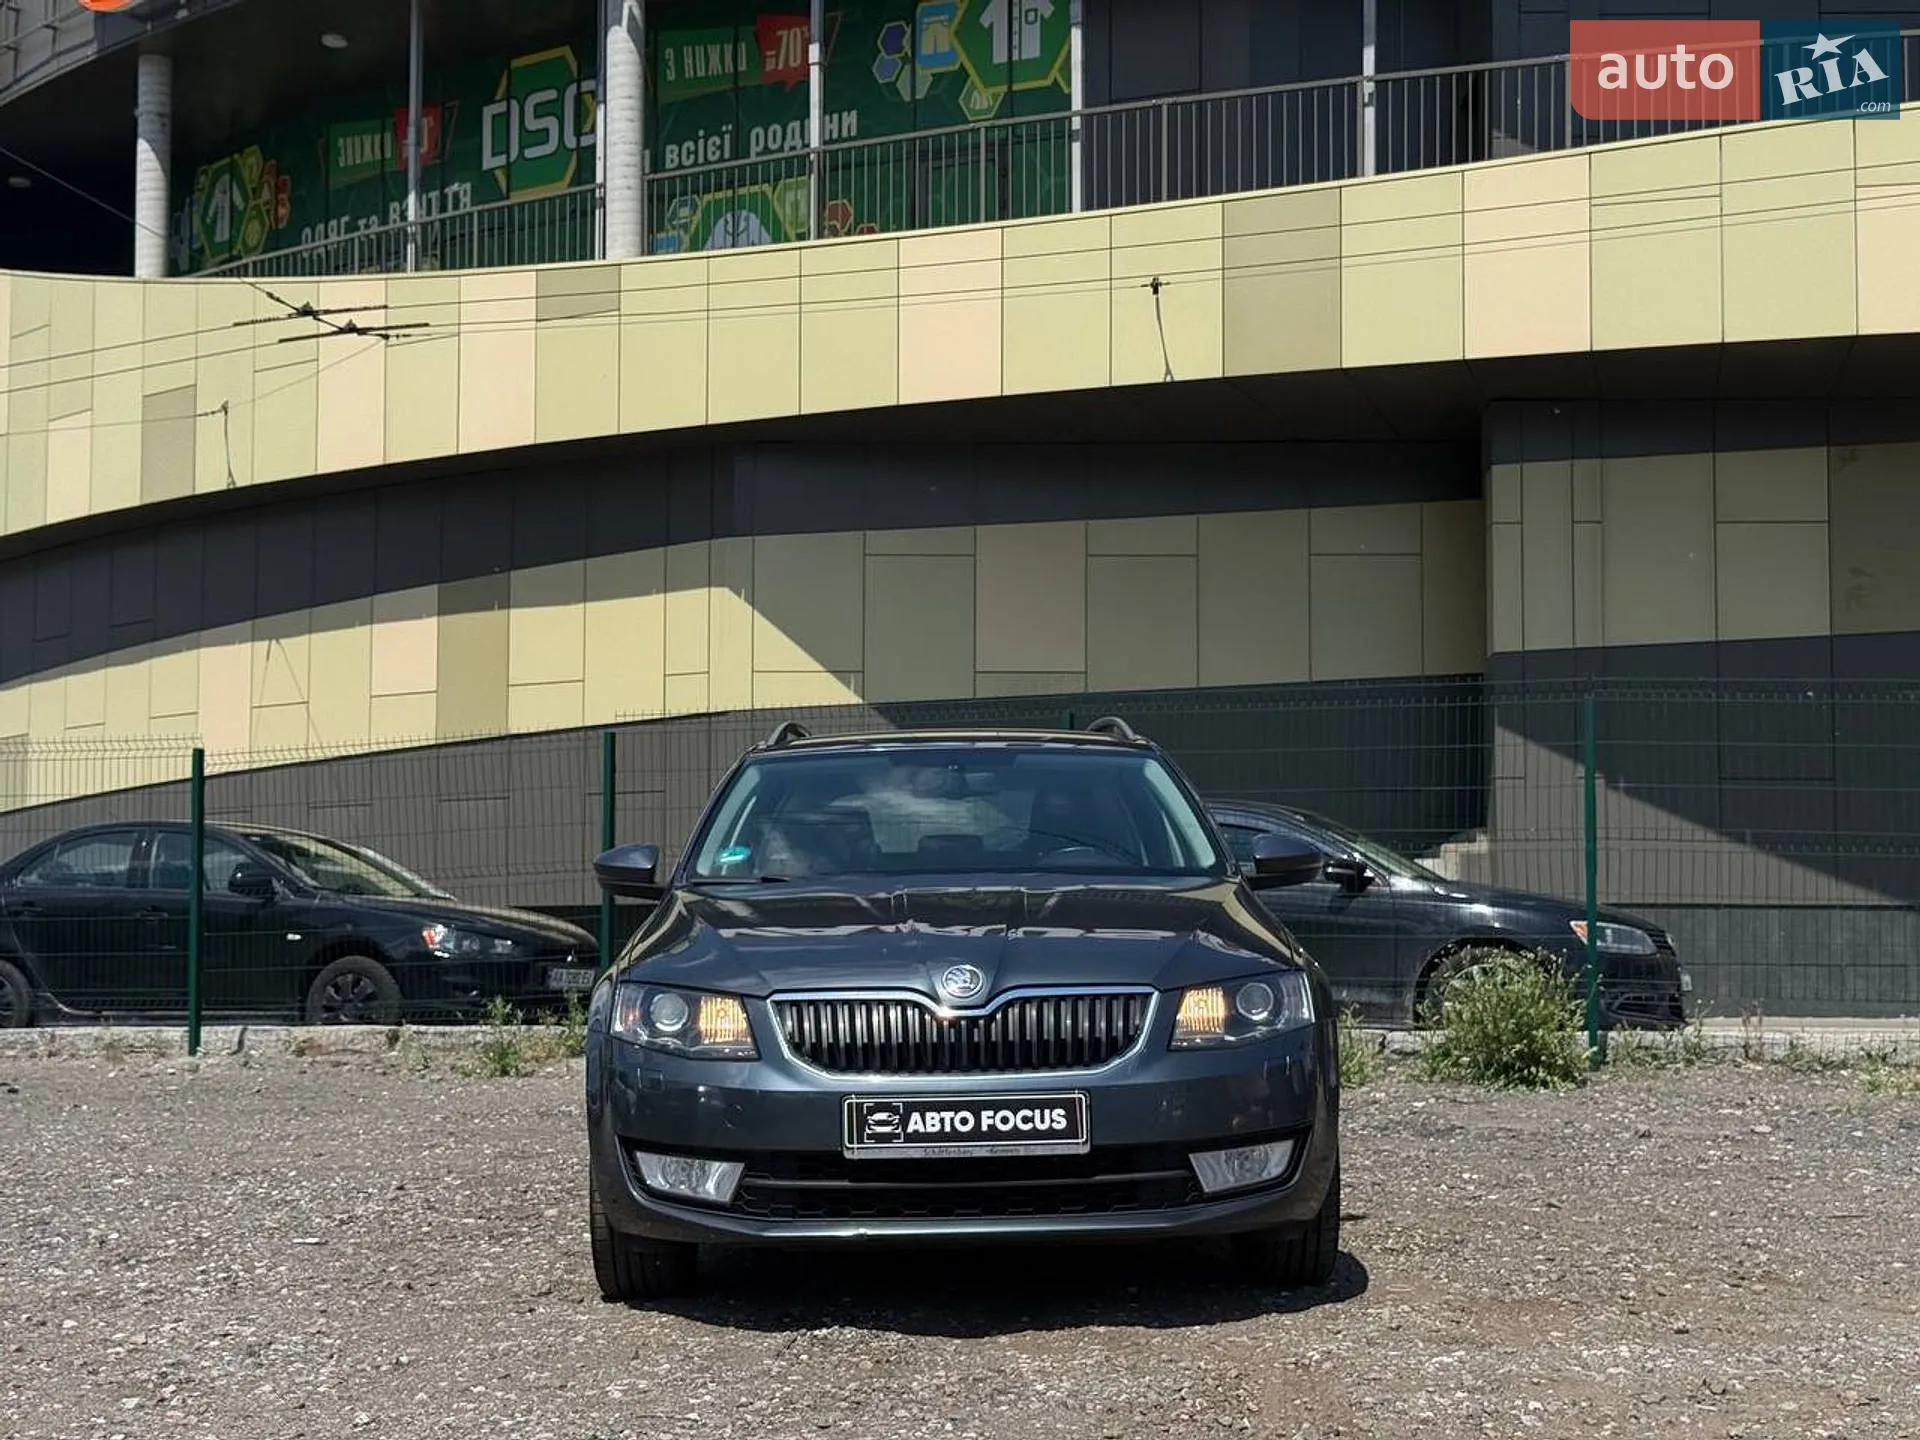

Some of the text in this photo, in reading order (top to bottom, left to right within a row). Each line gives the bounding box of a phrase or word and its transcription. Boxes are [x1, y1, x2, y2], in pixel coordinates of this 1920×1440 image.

[665, 123, 733, 169] всієї
[906, 1108, 1068, 1133] АВТО FOCUS
